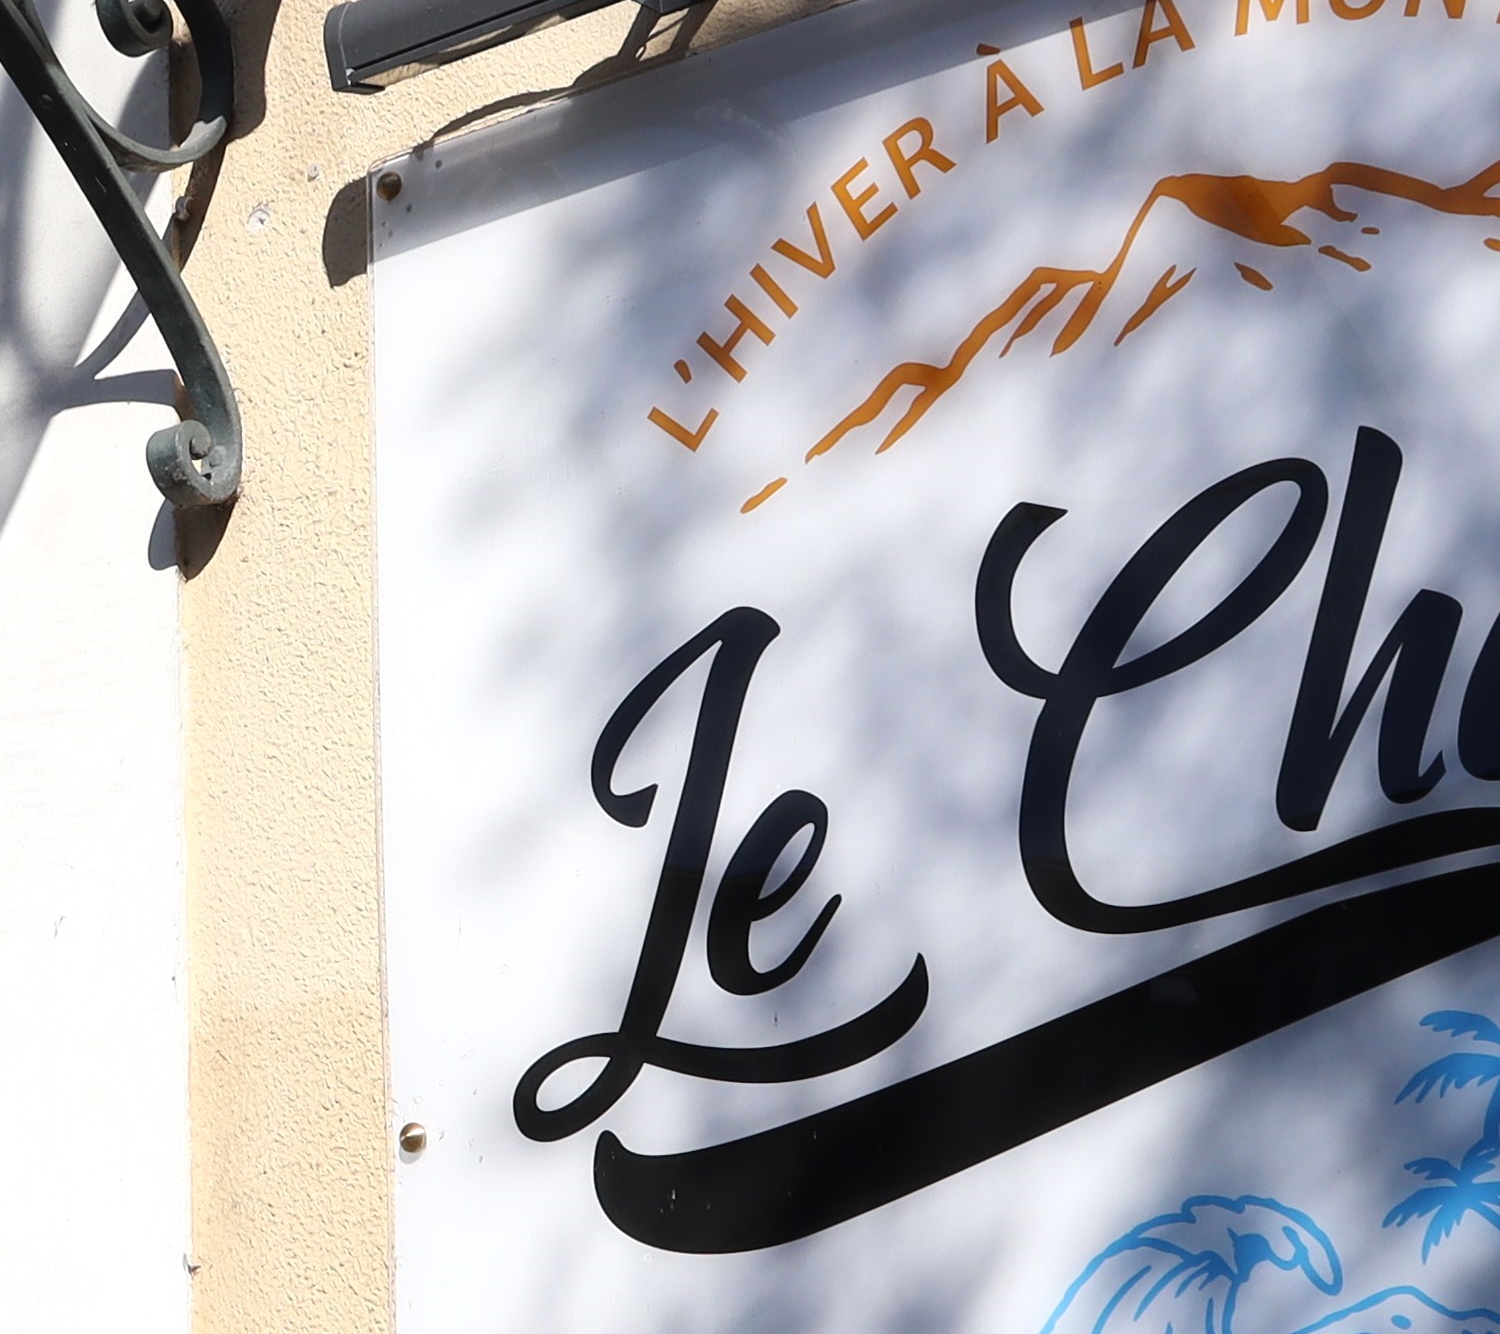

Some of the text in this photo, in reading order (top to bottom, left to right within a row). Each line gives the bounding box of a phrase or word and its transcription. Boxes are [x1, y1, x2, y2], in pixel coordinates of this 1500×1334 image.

[646, 116, 957, 453] L'HIVER
[975, 42, 1046, 145] À
[513, 605, 930, 1144] Le
